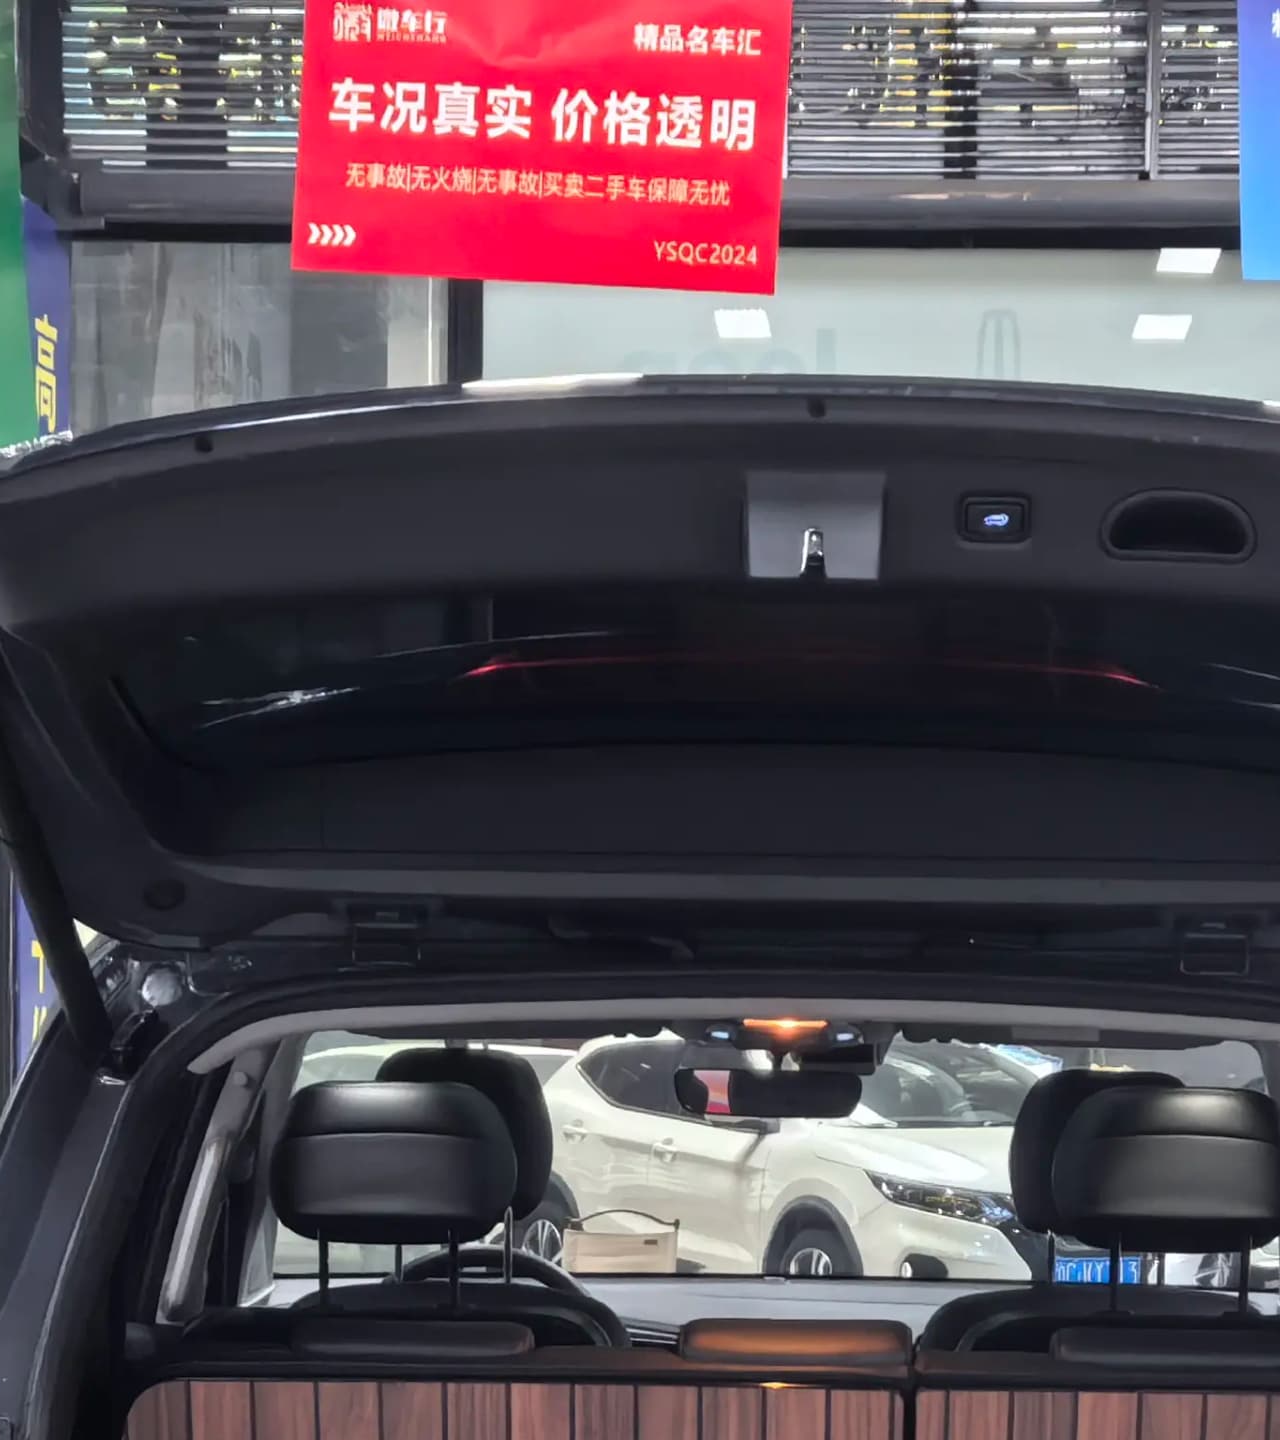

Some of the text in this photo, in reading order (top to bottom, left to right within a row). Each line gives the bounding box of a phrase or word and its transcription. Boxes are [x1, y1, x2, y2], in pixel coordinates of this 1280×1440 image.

[633, 22, 762, 56] 精品名车汇
[328, 77, 757, 152] 车况真实 价格透明
[653, 240, 759, 265] YSQC2024
